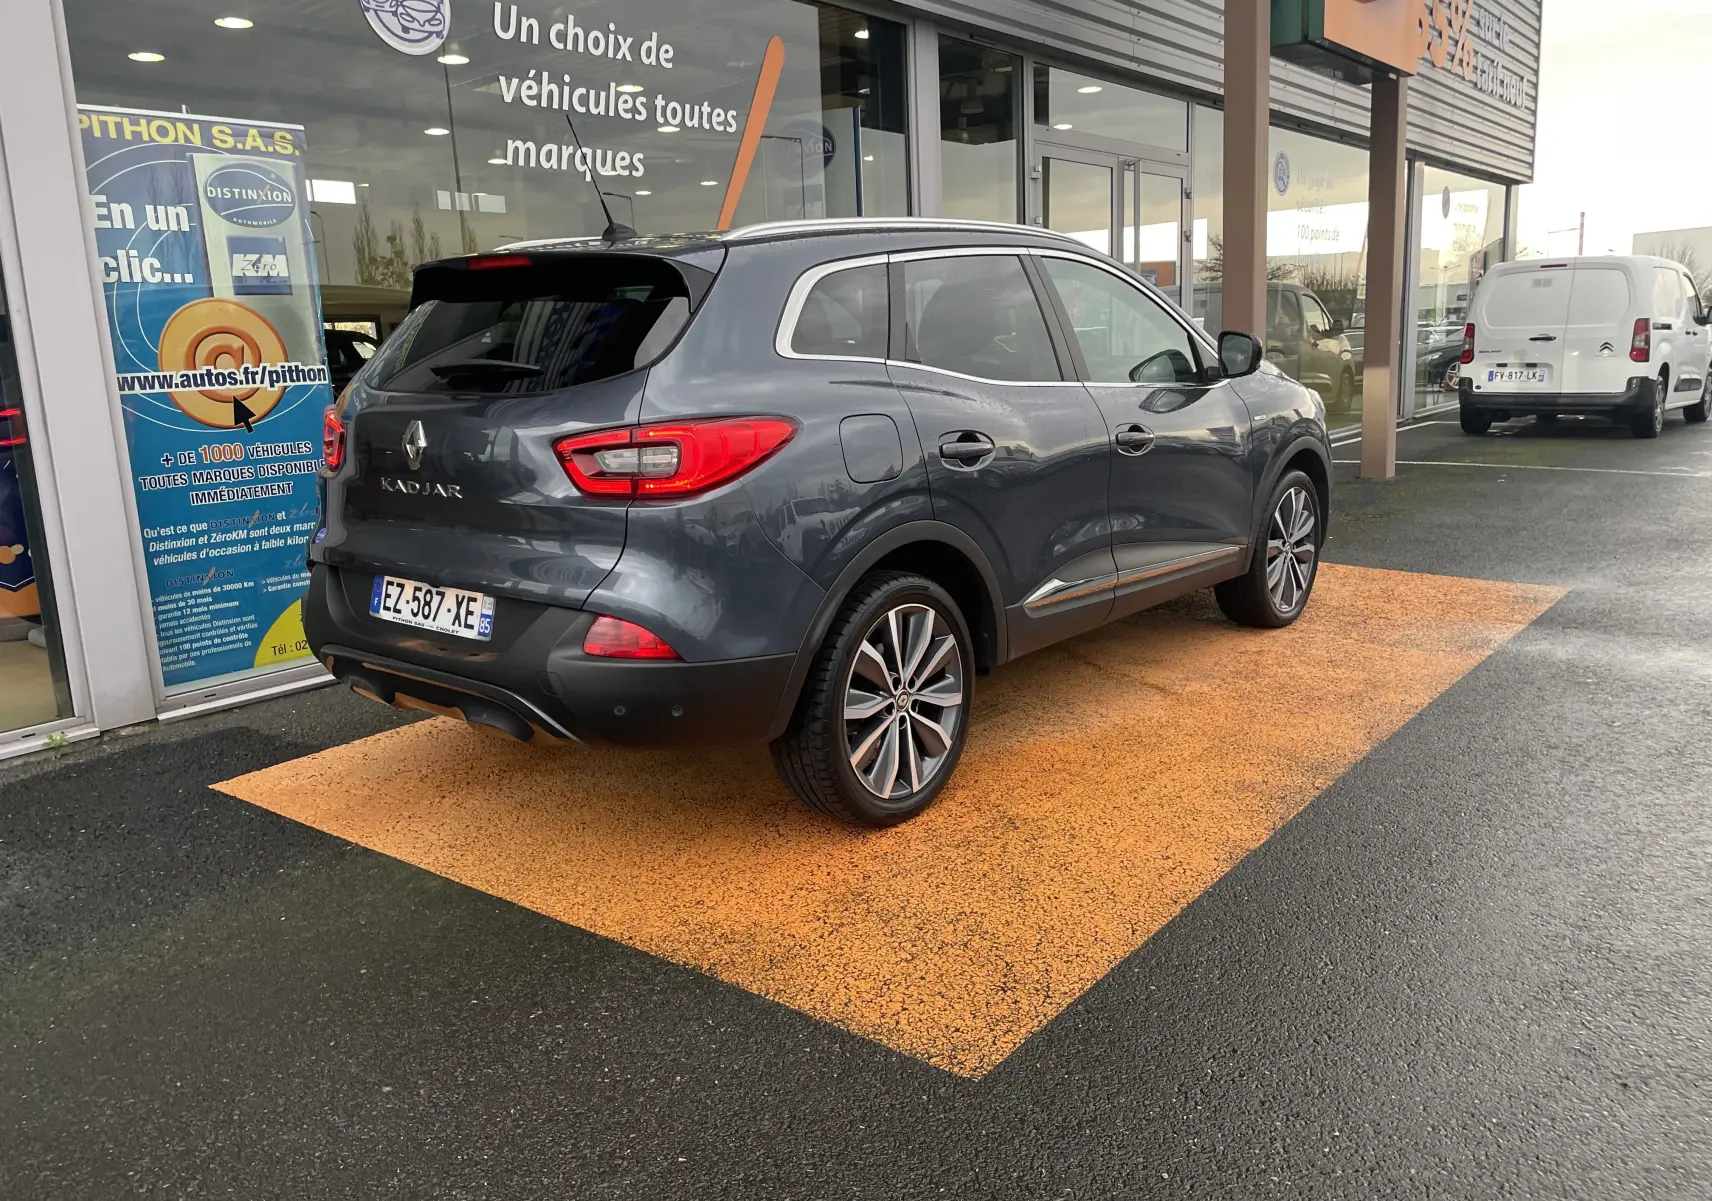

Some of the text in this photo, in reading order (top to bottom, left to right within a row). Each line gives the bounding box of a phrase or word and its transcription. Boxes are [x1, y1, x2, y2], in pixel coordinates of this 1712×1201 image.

[493, 1, 674, 69] Un choix de
[1478, 8, 1499, 44] sur
[498, 69, 737, 133] véhicules toutes
[211, 126, 300, 155] S.A.S.
[506, 139, 645, 182] marques
[207, 185, 292, 203] DISTINXION
[92, 194, 190, 231] En un
[1298, 225, 1339, 245] 100 points de
[101, 249, 194, 284] clic...
[117, 365, 327, 392] www.autos.fr/pithon
[162, 441, 312, 467] + DE 1000 VÉHICULES
[140, 474, 188, 490] TOUTES
[193, 466, 255, 485] MARQUES
[380, 477, 463, 499] KADJAR
[190, 483, 293, 506] IMMÉDIATEMENT
[144, 525, 174, 539] Qu'est
[177, 525, 187, 533] ce
[190, 522, 208, 533] que
[210, 510, 275, 529] DISTINXION
[277, 510, 286, 520] et
[149, 537, 196, 552] Distinxion
[198, 534, 208, 545] et
[210, 530, 247, 544] ZéroKM
[249, 527, 268, 538] sont
[270, 524, 292, 534] deux
[153, 551, 198, 566] véhicules
[200, 544, 252, 559] d'occasion
[253, 541, 259, 551] à
[262, 537, 285, 549] faible
[166, 567, 234, 588] DISTINXION
[191, 587, 212, 596] moins
[222, 583, 243, 591] 30000
[192, 605, 208, 613] mois
[209, 600, 240, 611] minimum
[197, 595, 213, 604] mois
[374, 597, 379, 606] F
[382, 580, 478, 631] EZ-587-XE
[479, 616, 491, 634] 85
[392, 616, 413, 625] PITHON
[414, 620, 425, 628] SAS
[435, 625, 460, 635] CHOLET
[271, 643, 287, 656] Tél
[295, 640, 308, 651] 02
